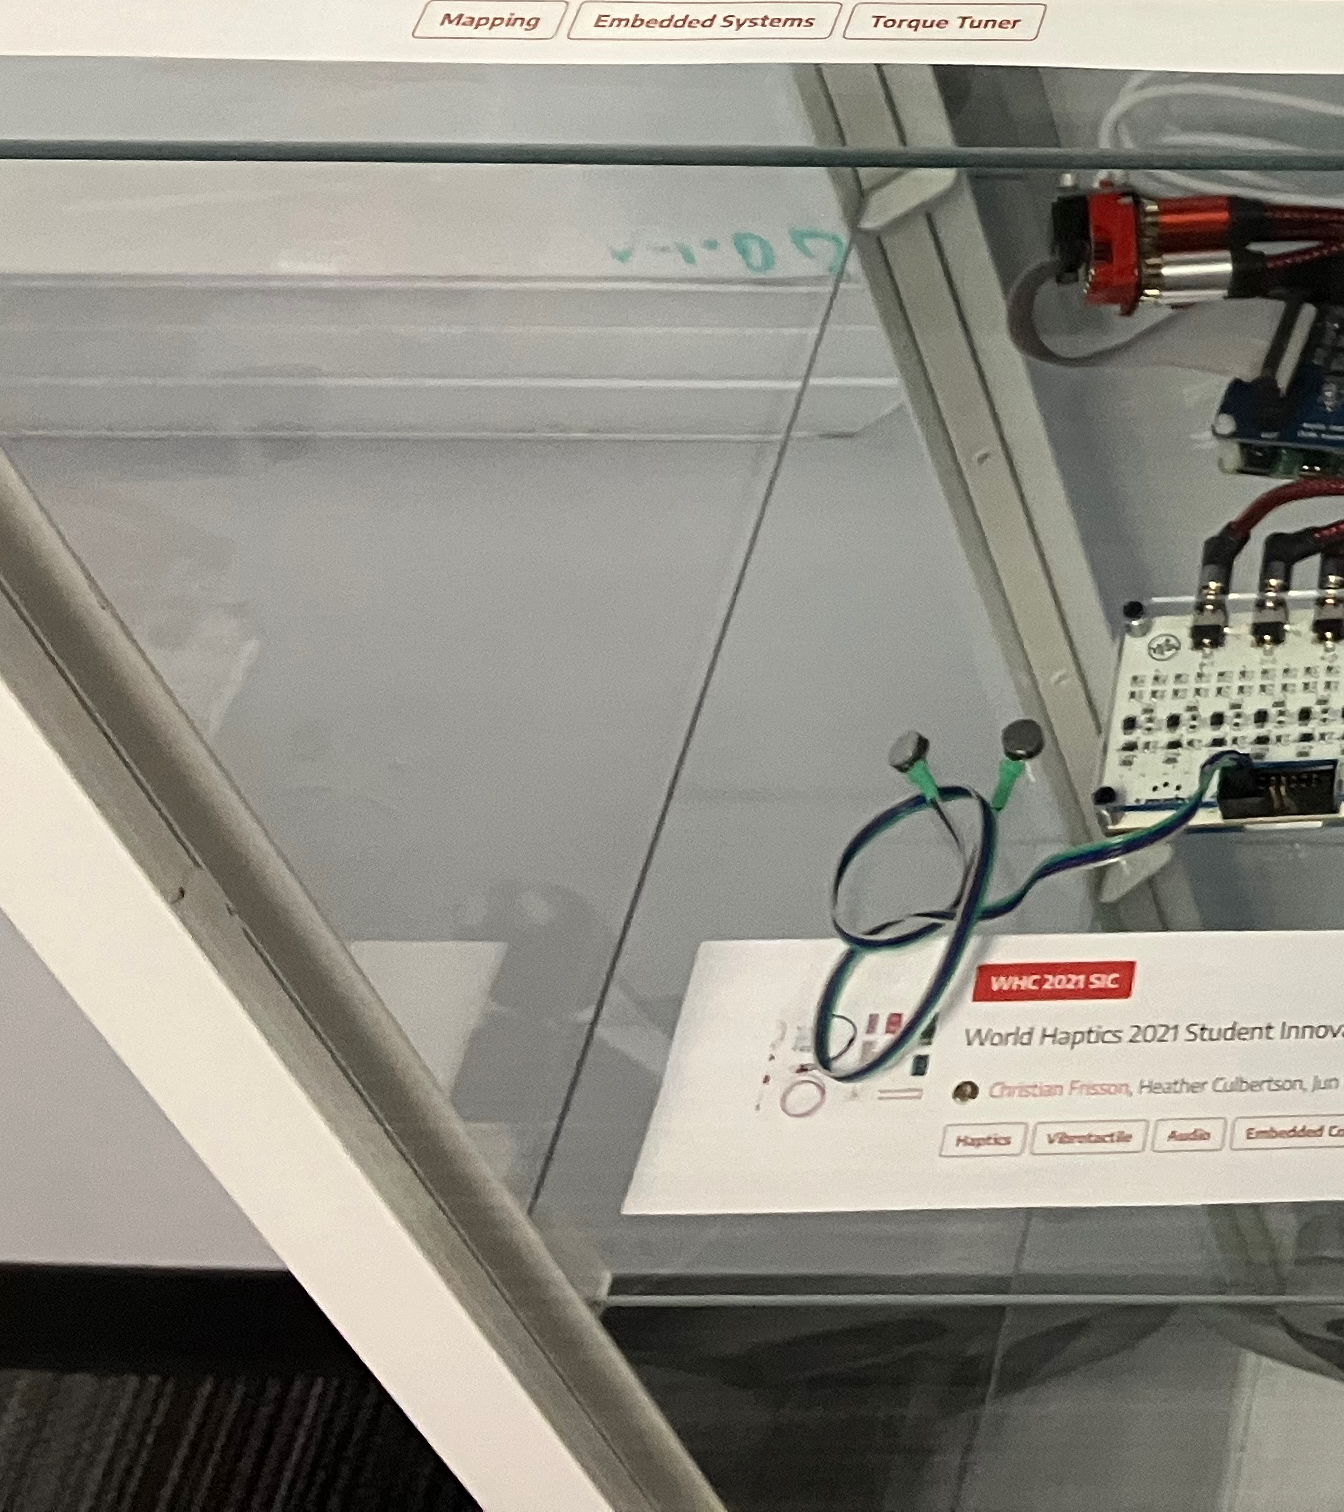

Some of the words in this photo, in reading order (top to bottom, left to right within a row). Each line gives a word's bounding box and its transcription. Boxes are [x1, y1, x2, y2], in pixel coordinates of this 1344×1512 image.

[440, 13, 540, 32] Mapping
[594, 13, 715, 30] Embedded
[720, 14, 816, 33] Systems
[871, 14, 949, 33] Torque
[955, 15, 1021, 30] Tuner
[990, 974, 1039, 991] WHC
[1043, 974, 1085, 990] 2021
[1089, 973, 1120, 989] SIC
[965, 1027, 1036, 1047] World
[1042, 1026, 1123, 1050] Haptics
[1129, 1025, 1179, 1044] 2021
[1185, 1022, 1275, 1042] Student
[989, 1081, 1063, 1099] Christian
[1139, 1078, 1208, 1095] Heather
[1212, 1075, 1307, 1094] Culbertson,
[1312, 1075, 1339, 1093] Jun
[956, 1133, 1011, 1149] Haptics
[1168, 1127, 1210, 1142] Audio
[1246, 1125, 1323, 1140] Embedded
